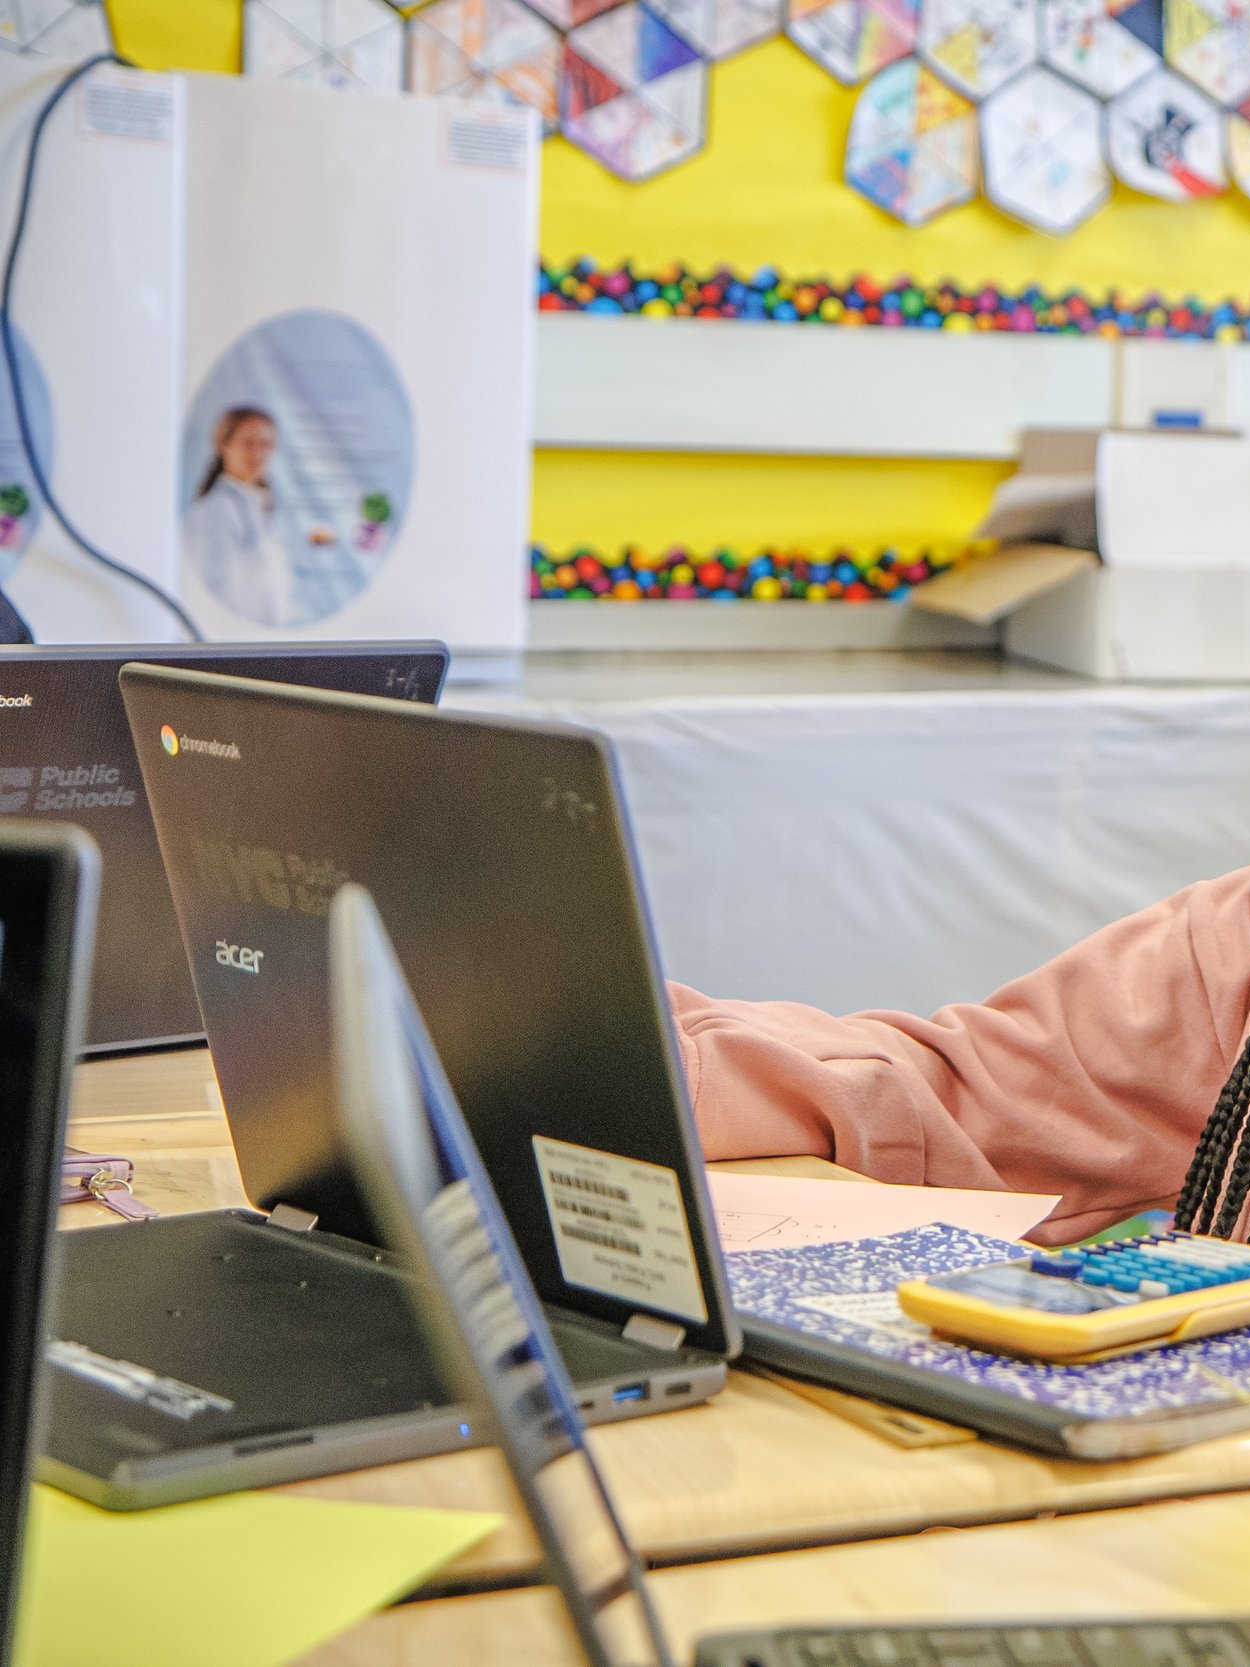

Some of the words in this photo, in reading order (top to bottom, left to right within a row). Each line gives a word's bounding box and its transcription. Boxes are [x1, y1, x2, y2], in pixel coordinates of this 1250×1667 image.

[179, 733, 241, 759] chromebook
[39, 763, 121, 787] Public
[34, 786, 137, 811] Schools
[215, 938, 265, 974] acer
